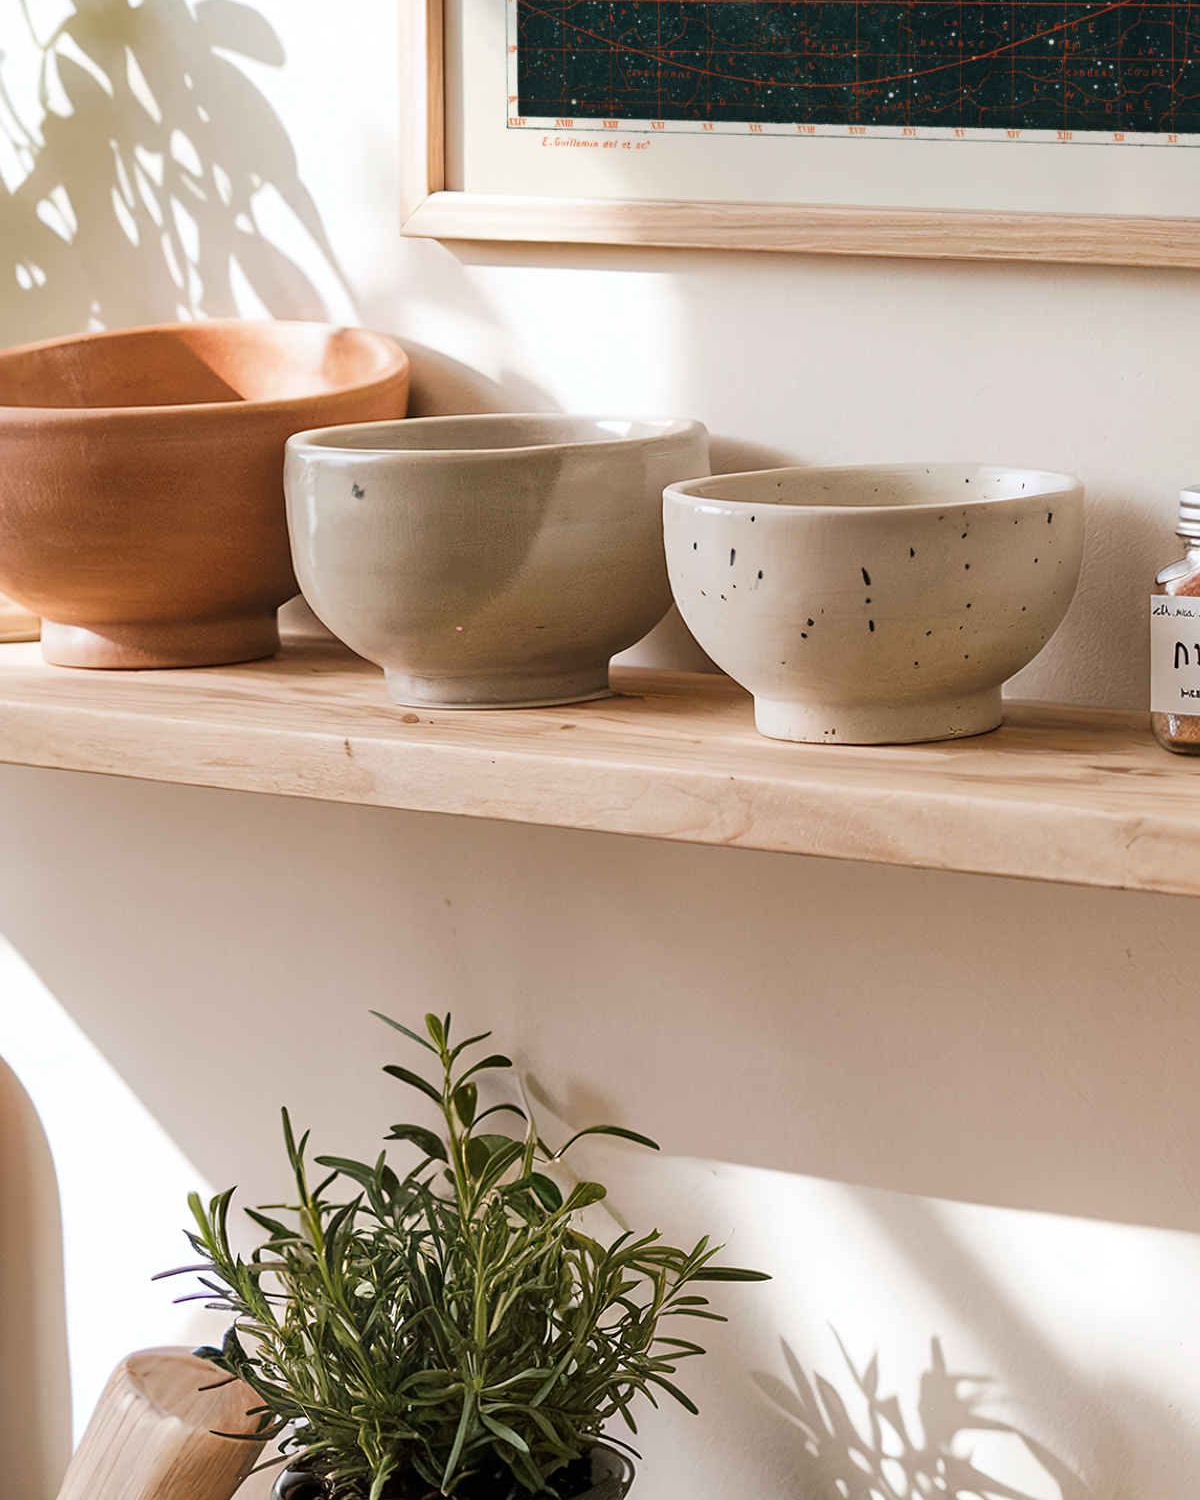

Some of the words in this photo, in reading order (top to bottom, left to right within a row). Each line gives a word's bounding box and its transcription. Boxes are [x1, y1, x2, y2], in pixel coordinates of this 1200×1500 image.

[1138, 47, 1154, 56] LA
[626, 70, 692, 78] CAPRICORNE
[1066, 68, 1115, 77] CORBEAU
[1127, 68, 1165, 77] COUPE
[602, 138, 617, 149] del
[621, 140, 631, 149] et
